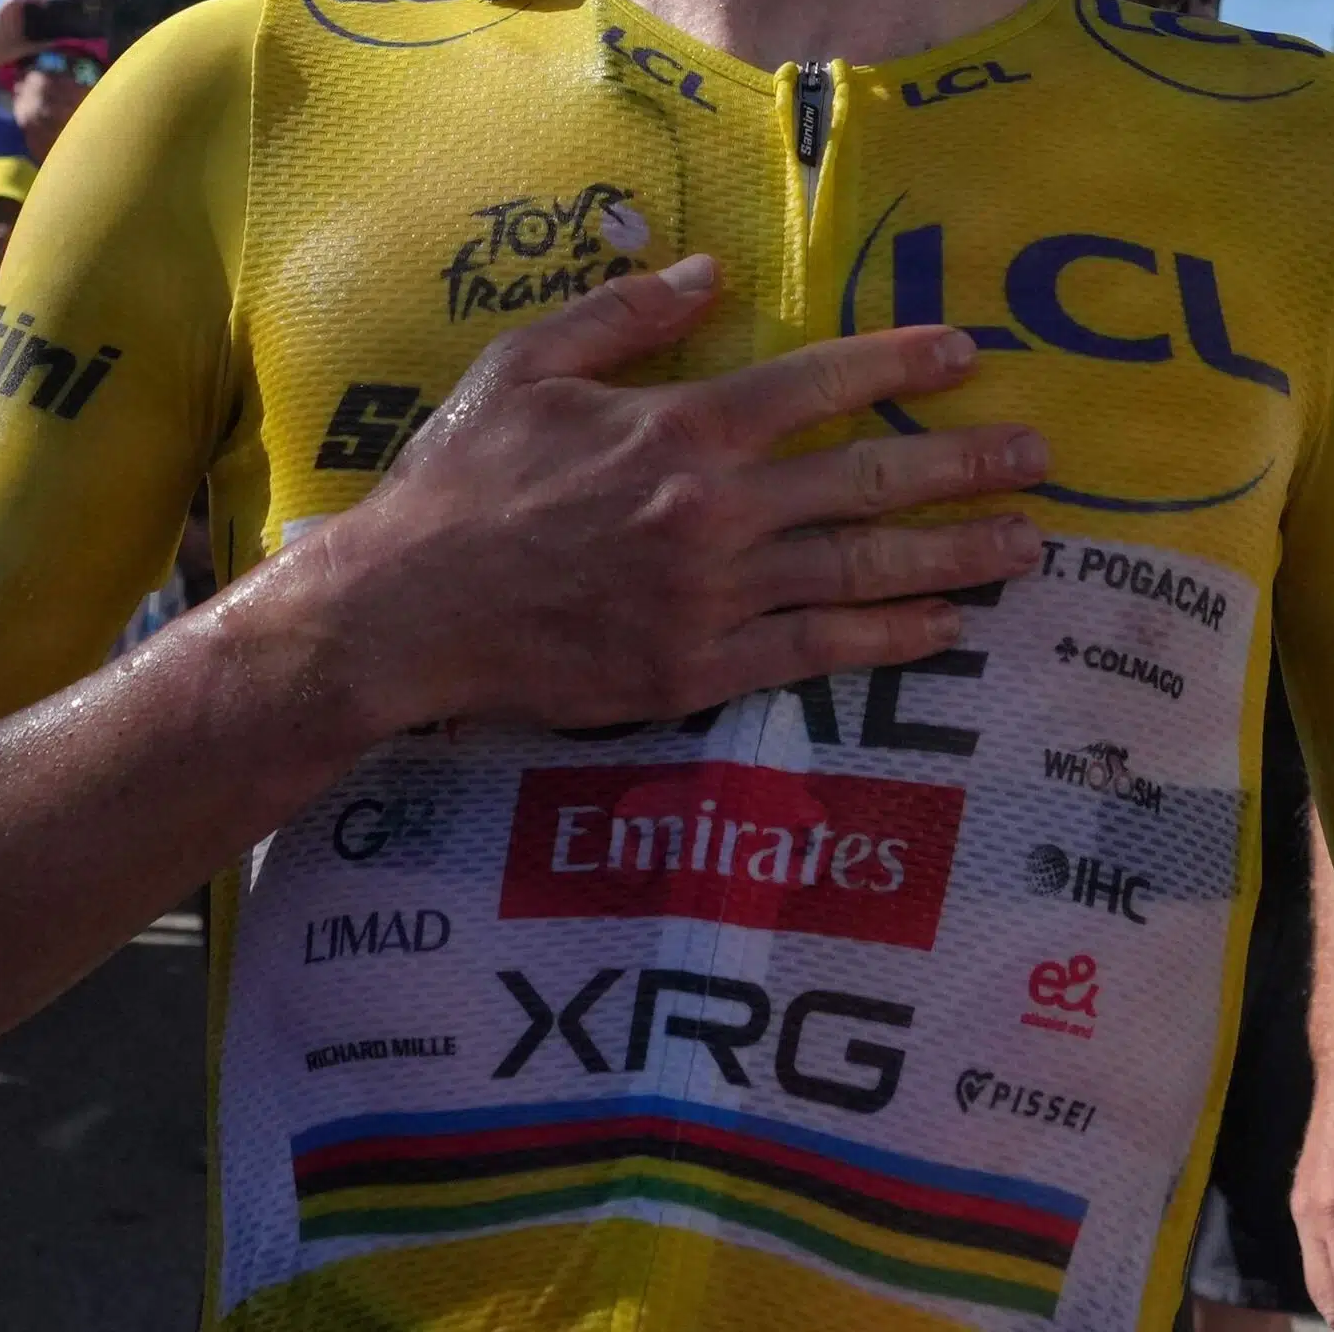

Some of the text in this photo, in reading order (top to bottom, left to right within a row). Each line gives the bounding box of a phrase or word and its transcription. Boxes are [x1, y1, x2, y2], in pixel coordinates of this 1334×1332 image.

[601, 26, 717, 113] LCL
[901, 61, 1032, 108] LCL
[800, 104, 816, 157] Santini
[893, 224, 1290, 397] LCL
[1042, 541, 1228, 631] T. POGACAR
[1084, 645, 1184, 699] COLNAGO
[1044, 748, 1163, 815] WHOOSH
[551, 799, 909, 894] Emirates
[1073, 856, 1151, 924] IHC
[304, 909, 451, 965] L'IMAD
[305, 1035, 457, 1072] RICHARD MILLE
[491, 969, 915, 1115] XRG
[992, 1083, 1096, 1133] PISSEI
